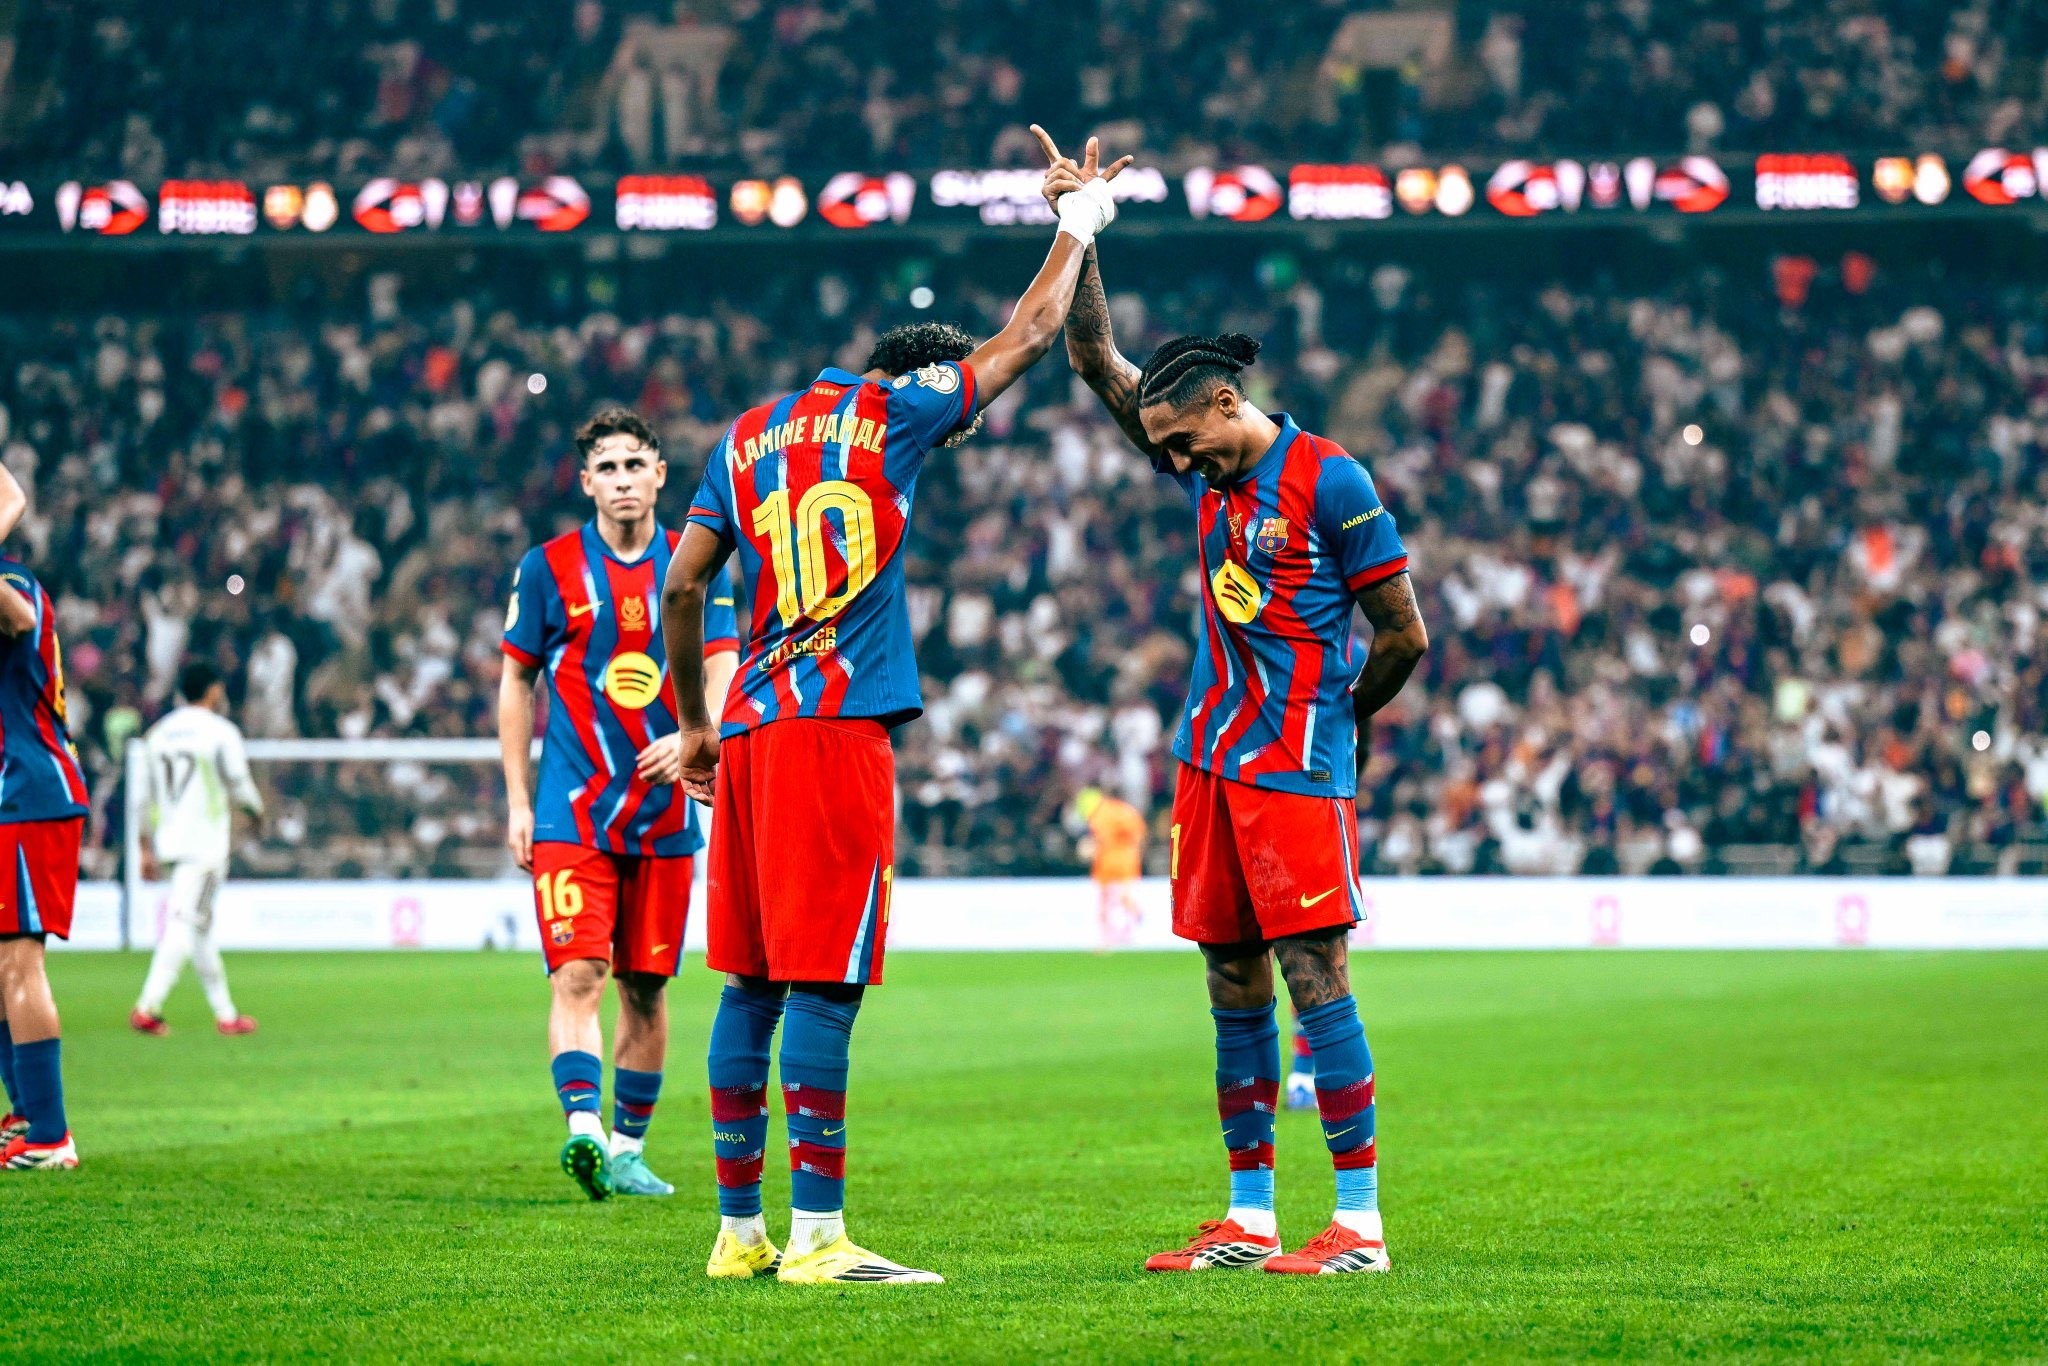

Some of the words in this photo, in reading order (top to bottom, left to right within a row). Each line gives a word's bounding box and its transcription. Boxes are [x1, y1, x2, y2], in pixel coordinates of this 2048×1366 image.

[733, 416, 808, 473] LAMINE
[812, 414, 887, 454] YAMAL
[751, 480, 877, 627] 10
[536, 868, 583, 922] 16
